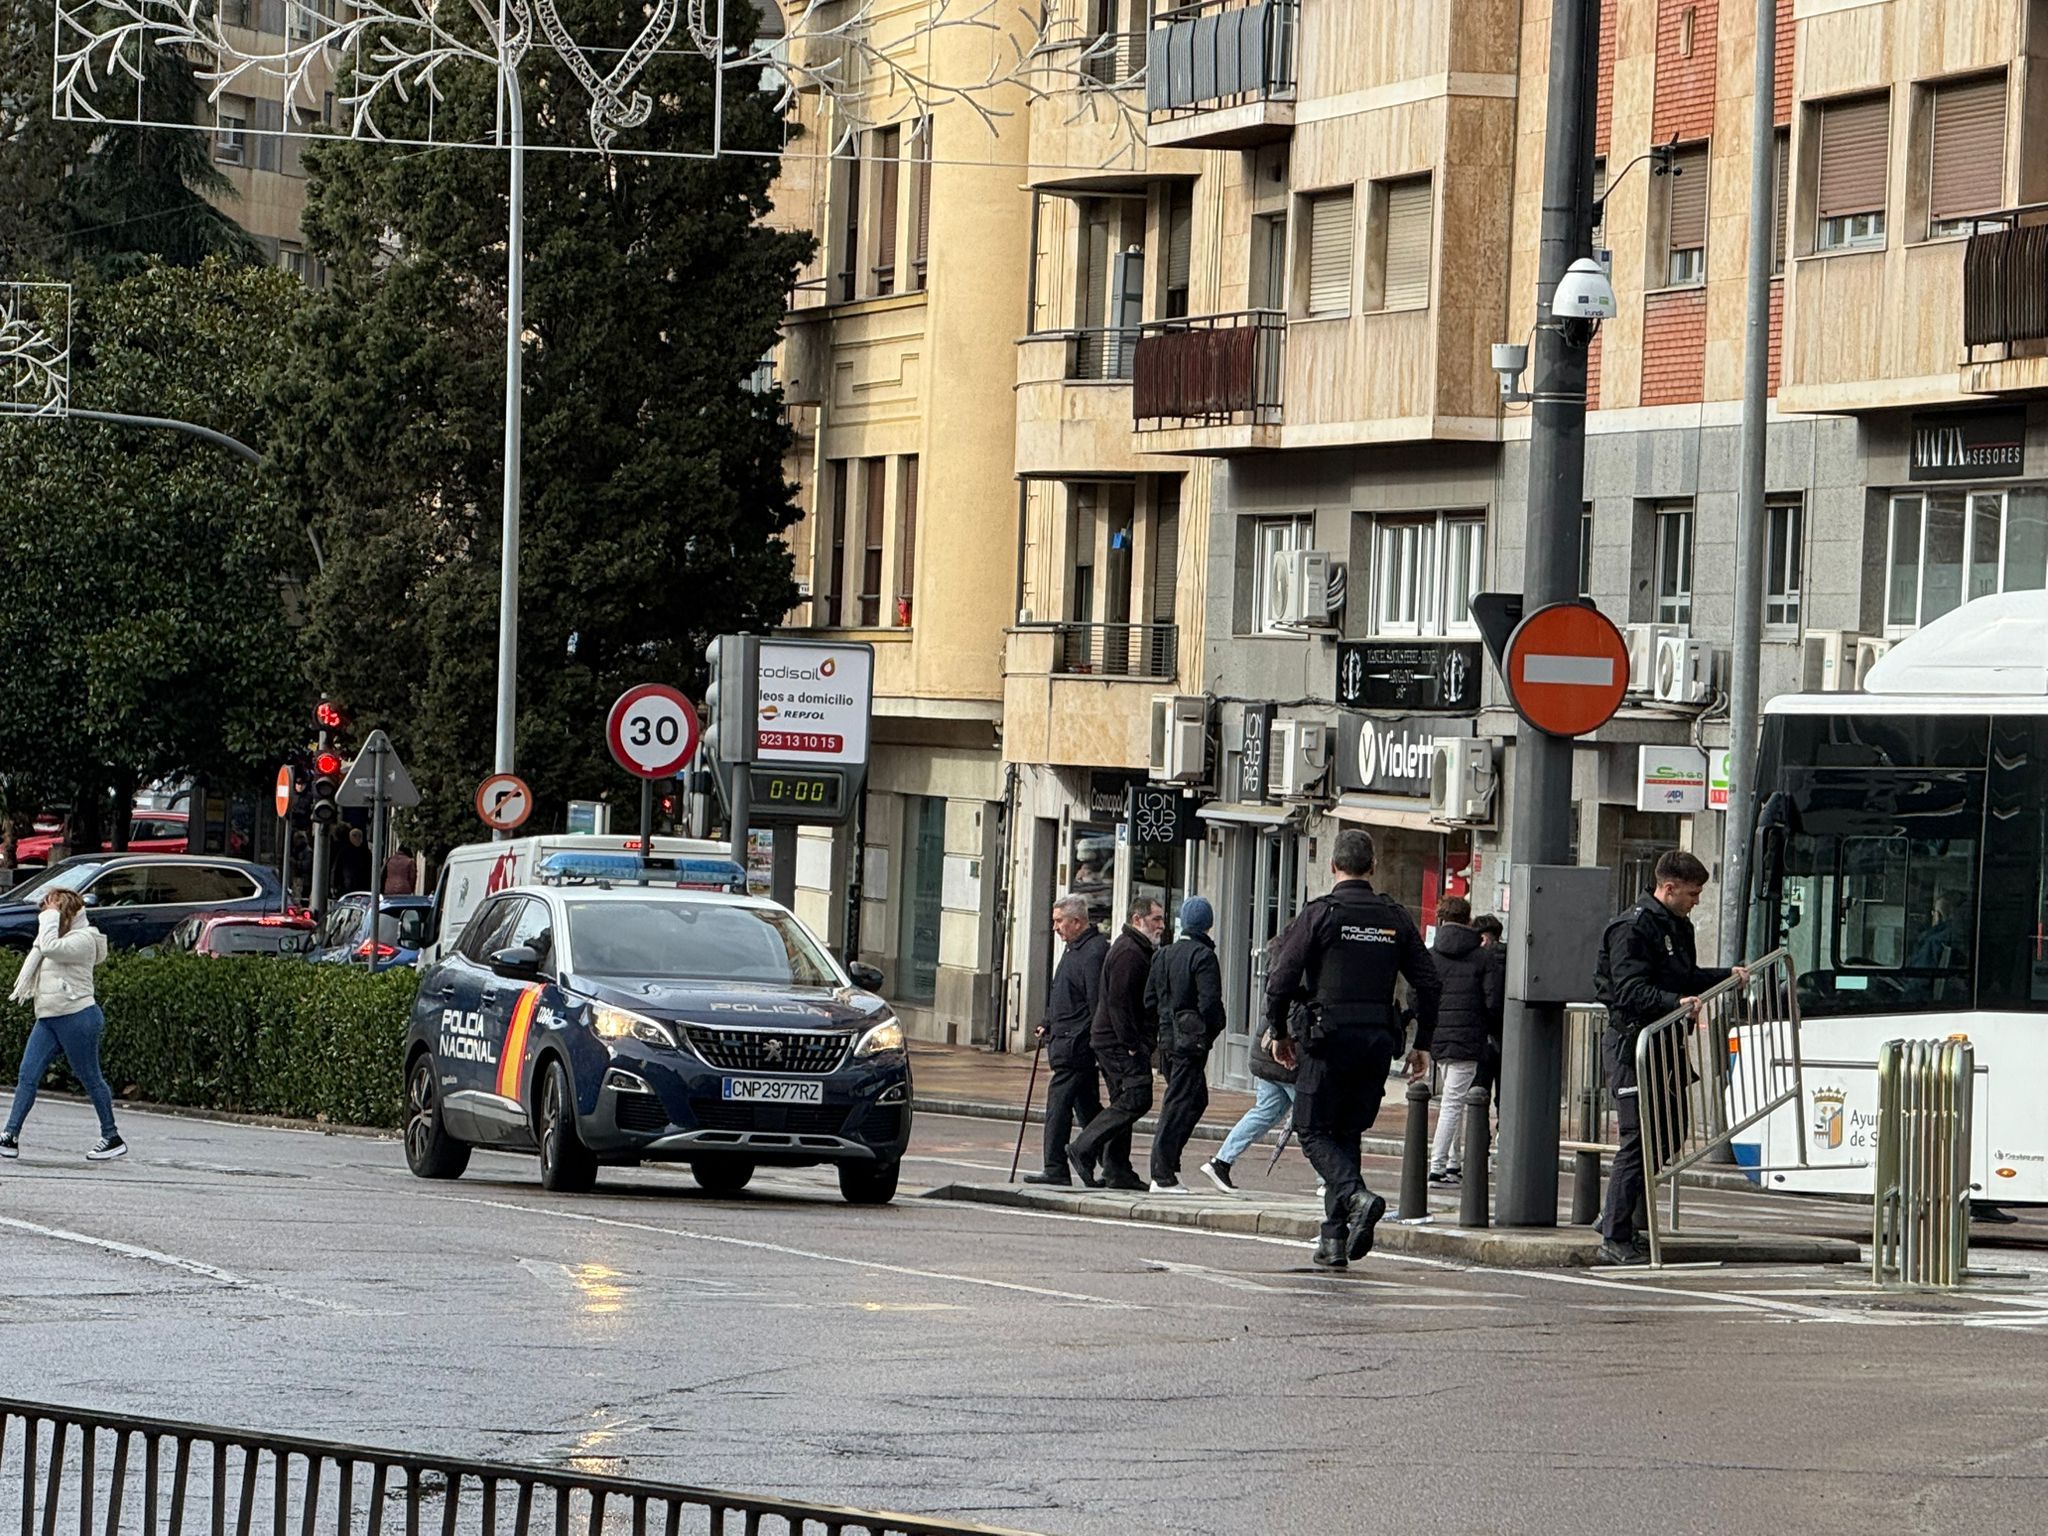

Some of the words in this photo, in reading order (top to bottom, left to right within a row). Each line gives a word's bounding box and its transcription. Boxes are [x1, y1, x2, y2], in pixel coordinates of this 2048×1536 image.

[1966, 447, 2020, 466] ASESORES
[787, 694, 795, 702] a
[798, 691, 853, 706] domicilio
[784, 710, 825, 720] REPSOL
[630, 716, 679, 747] 30
[760, 733, 782, 747] 923
[786, 735, 800, 748] 13
[803, 736, 817, 748] 10
[820, 737, 835, 749] 15
[1378, 730, 1434, 779] Violett
[770, 780, 824, 801] 0:00
[1341, 933, 1395, 944] NACIONAL
[439, 1034, 497, 1064] NACIONAL
[732, 1080, 819, 1101] CNP2977RZ
[1850, 1130, 1866, 1147] de
[1870, 1131, 1879, 1148] S
